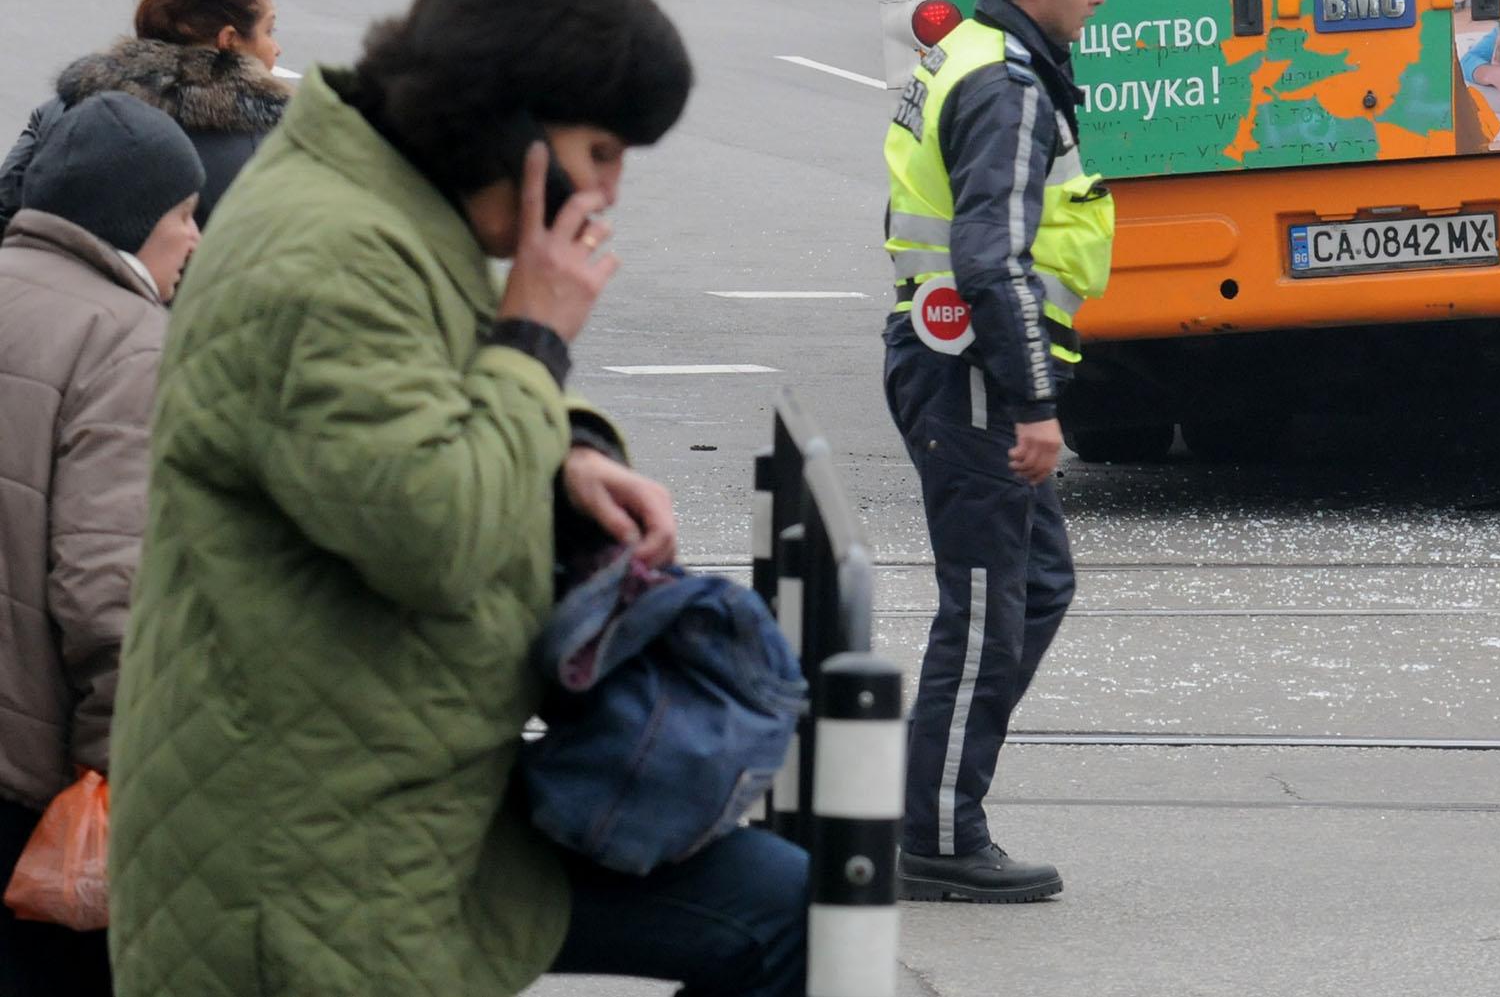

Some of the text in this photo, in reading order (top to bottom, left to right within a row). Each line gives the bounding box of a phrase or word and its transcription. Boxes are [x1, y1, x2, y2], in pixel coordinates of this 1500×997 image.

[1069, 16, 1218, 58] щество
[1294, 253, 1308, 263] BG
[927, 306, 966, 322] МВР
